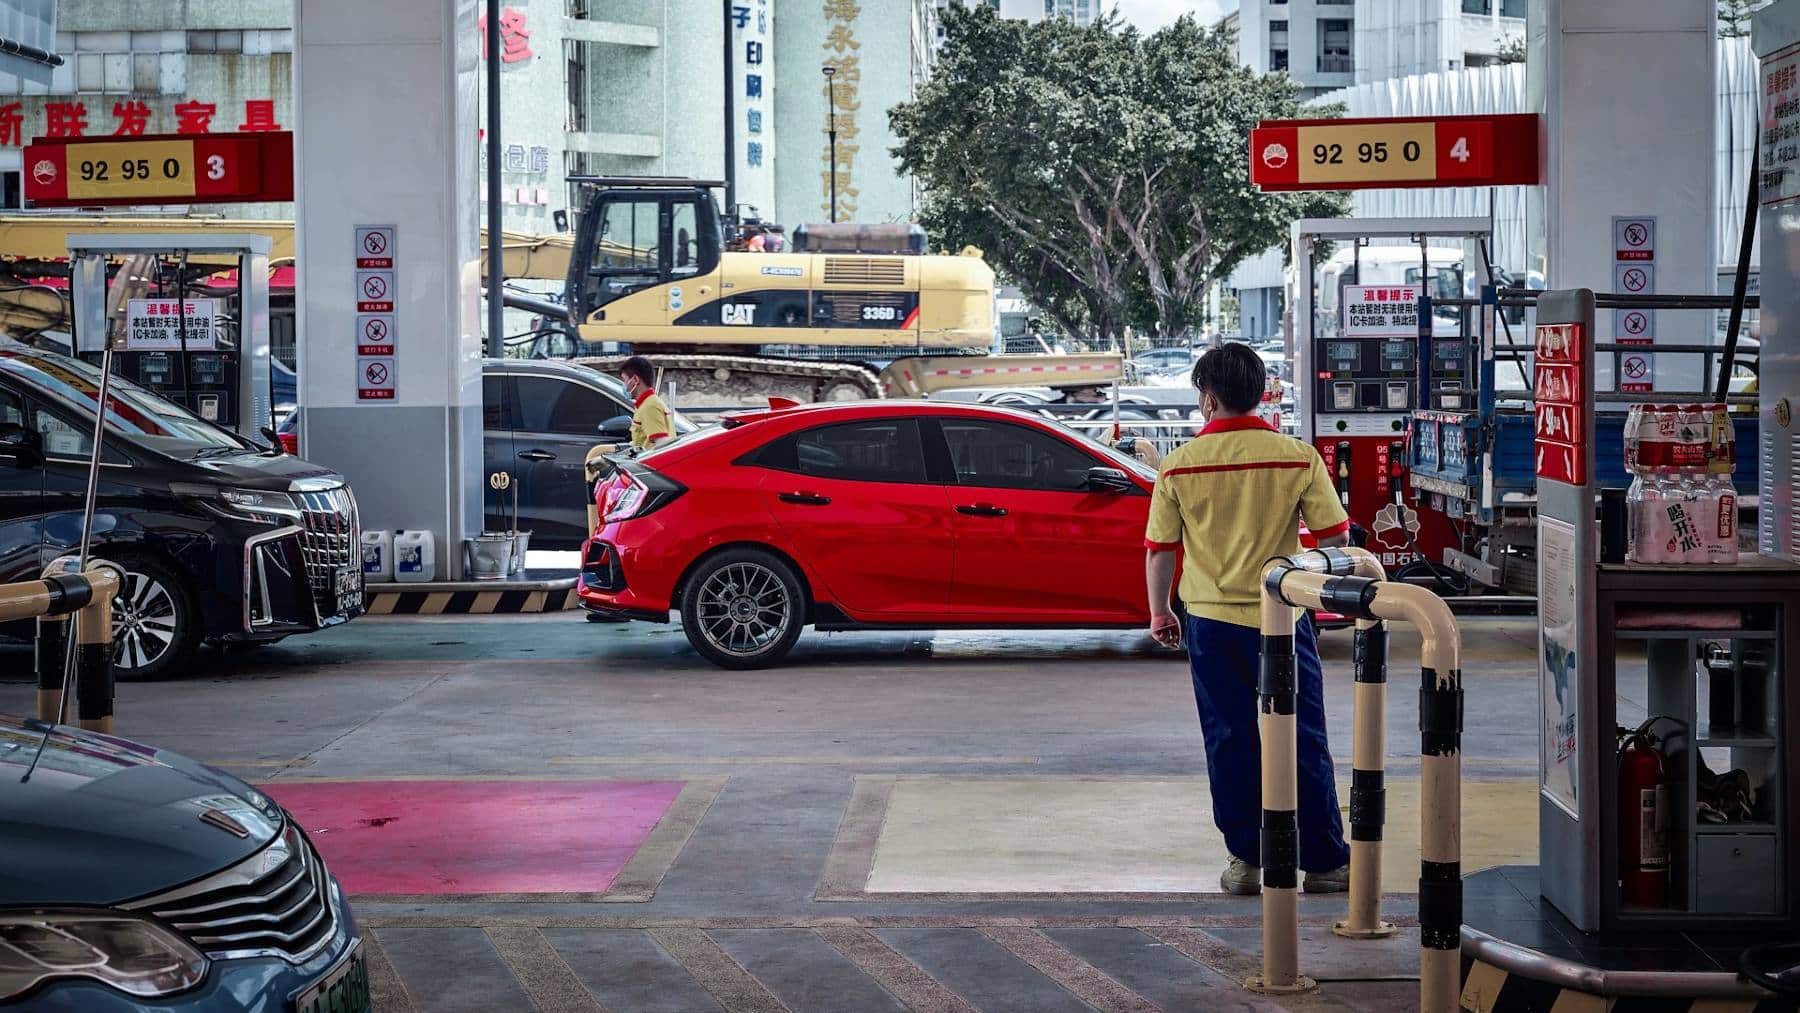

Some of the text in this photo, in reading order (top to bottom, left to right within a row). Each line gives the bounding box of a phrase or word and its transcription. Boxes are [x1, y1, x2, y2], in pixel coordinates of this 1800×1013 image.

[1313, 137, 1470, 164] 92 95 0 4
[80, 154, 226, 181] 92 95 0 3
[1364, 289, 1414, 301] 温馨提示
[146, 303, 196, 315] 温馨提示
[721, 304, 757, 325] CAT
[863, 307, 896, 320] 336D
